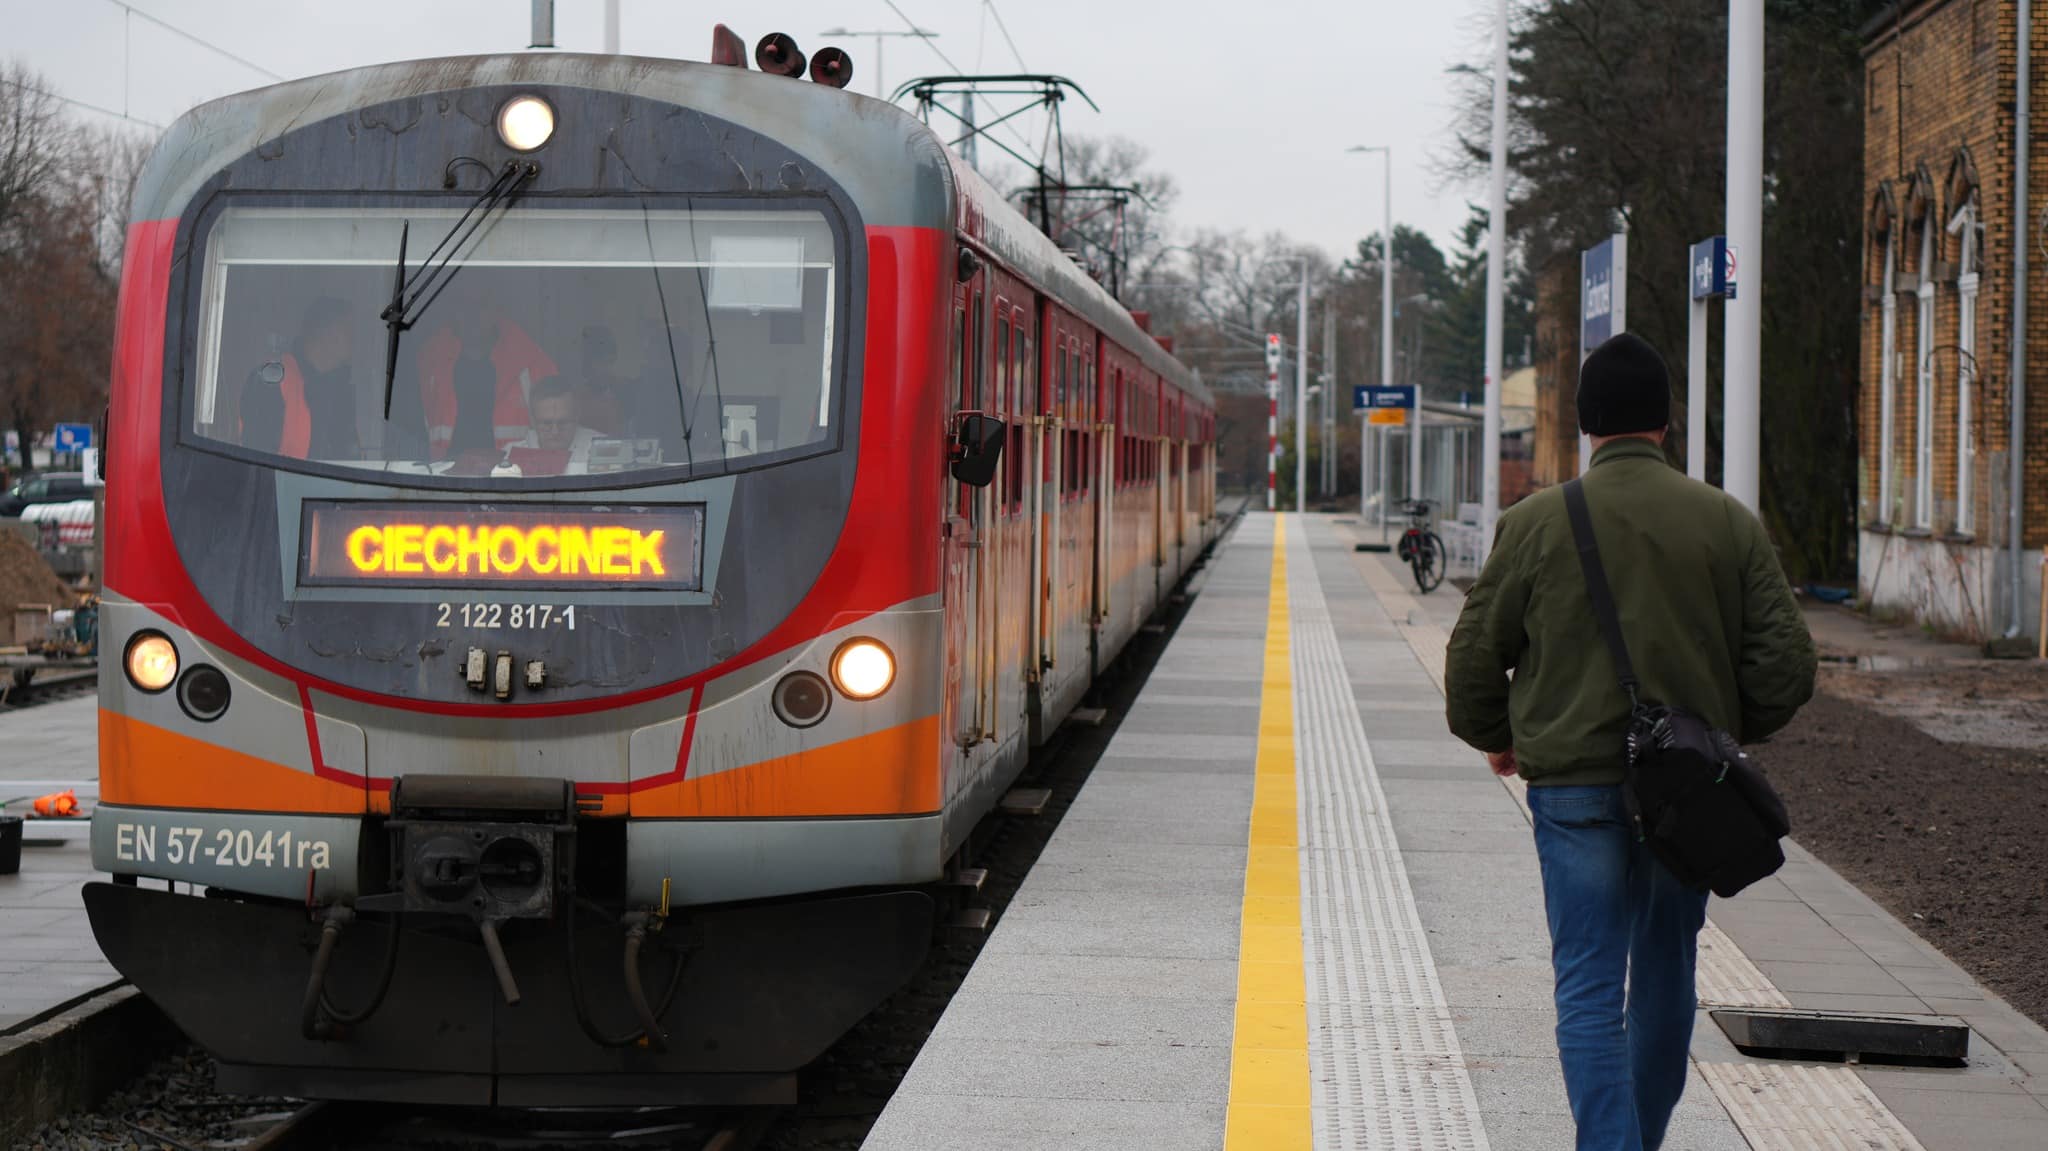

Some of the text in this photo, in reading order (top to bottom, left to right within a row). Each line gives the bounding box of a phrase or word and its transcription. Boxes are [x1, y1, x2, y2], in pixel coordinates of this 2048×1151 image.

[1361, 391, 1370, 406] 1
[348, 526, 665, 575] CIECHOCINEK
[436, 603, 576, 630] 2 122 817-1
[116, 823, 330, 869] EN 57-2041ra
